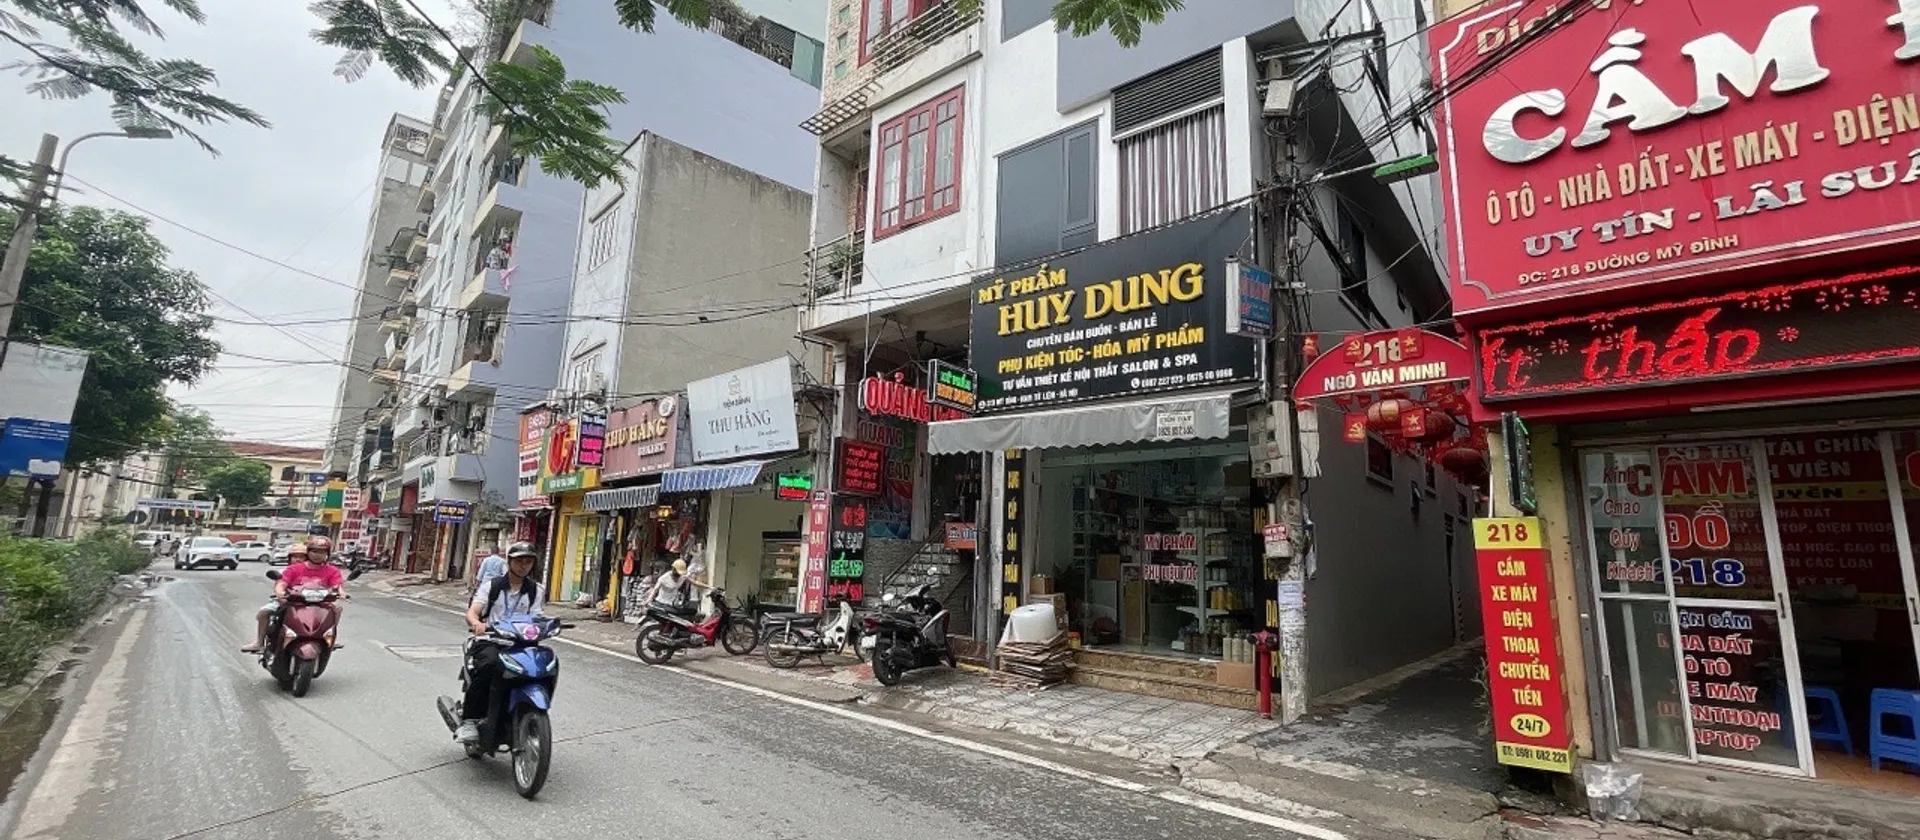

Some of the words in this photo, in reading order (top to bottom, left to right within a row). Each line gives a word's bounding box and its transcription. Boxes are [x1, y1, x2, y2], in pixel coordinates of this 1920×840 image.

[1482, 28, 1831, 165] CẦM
[1486, 189, 1502, 226] Ô
[1506, 181, 1536, 221] TÔ
[1558, 162, 1613, 209] NHÀ
[1618, 145, 1670, 196] ĐẤT
[1686, 140, 1727, 180] XE
[1733, 121, 1799, 171] MÁY
[1832, 92, 1920, 147] ĐIỆN
[1523, 226, 1583, 257] UY
[1592, 208, 1675, 244] TÍN
[1713, 180, 1808, 220] LÃI
[1518, 271, 1547, 285] ĐC:
[1551, 265, 1581, 279] 218
[1584, 250, 1651, 273] ĐƯỜNG
[1656, 244, 1685, 261] MỸ
[1689, 235, 1739, 255] ĐÌNH
[977, 277, 1008, 305] MỸ
[1009, 262, 1068, 297] PHẨM
[997, 288, 1077, 337] HUY
[1083, 261, 1205, 320] DUNG
[1119, 317, 1142, 333] BÁN
[1144, 311, 1158, 327] LẺ
[998, 356, 1023, 375] PHỤ
[1025, 350, 1055, 371] KIỆN
[1058, 344, 1085, 365] TÓC
[1093, 338, 1123, 360] HÓA
[1126, 332, 1151, 354] MỸ
[1155, 321, 1205, 350] PHẨM
[1580, 306, 1762, 381] thấp
[1121, 358, 1160, 375] SALON
[1162, 356, 1172, 369] &
[1174, 352, 1199, 367] SPA
[1360, 366, 1395, 388] VĂN
[1398, 361, 1448, 383] MINH
[864, 372, 931, 425] QUẢNG
[1486, 523, 1528, 543] 218
[1651, 557, 1747, 587] 218
[1491, 584, 1508, 602] XE
[1510, 582, 1538, 602] MÁY
[1503, 608, 1533, 631] ĐIỆN
[1501, 635, 1540, 658] THOẠI
[1701, 656, 1732, 677] TÔ
[1705, 680, 1758, 703] MÁY
[1515, 717, 1545, 734] 24/7
